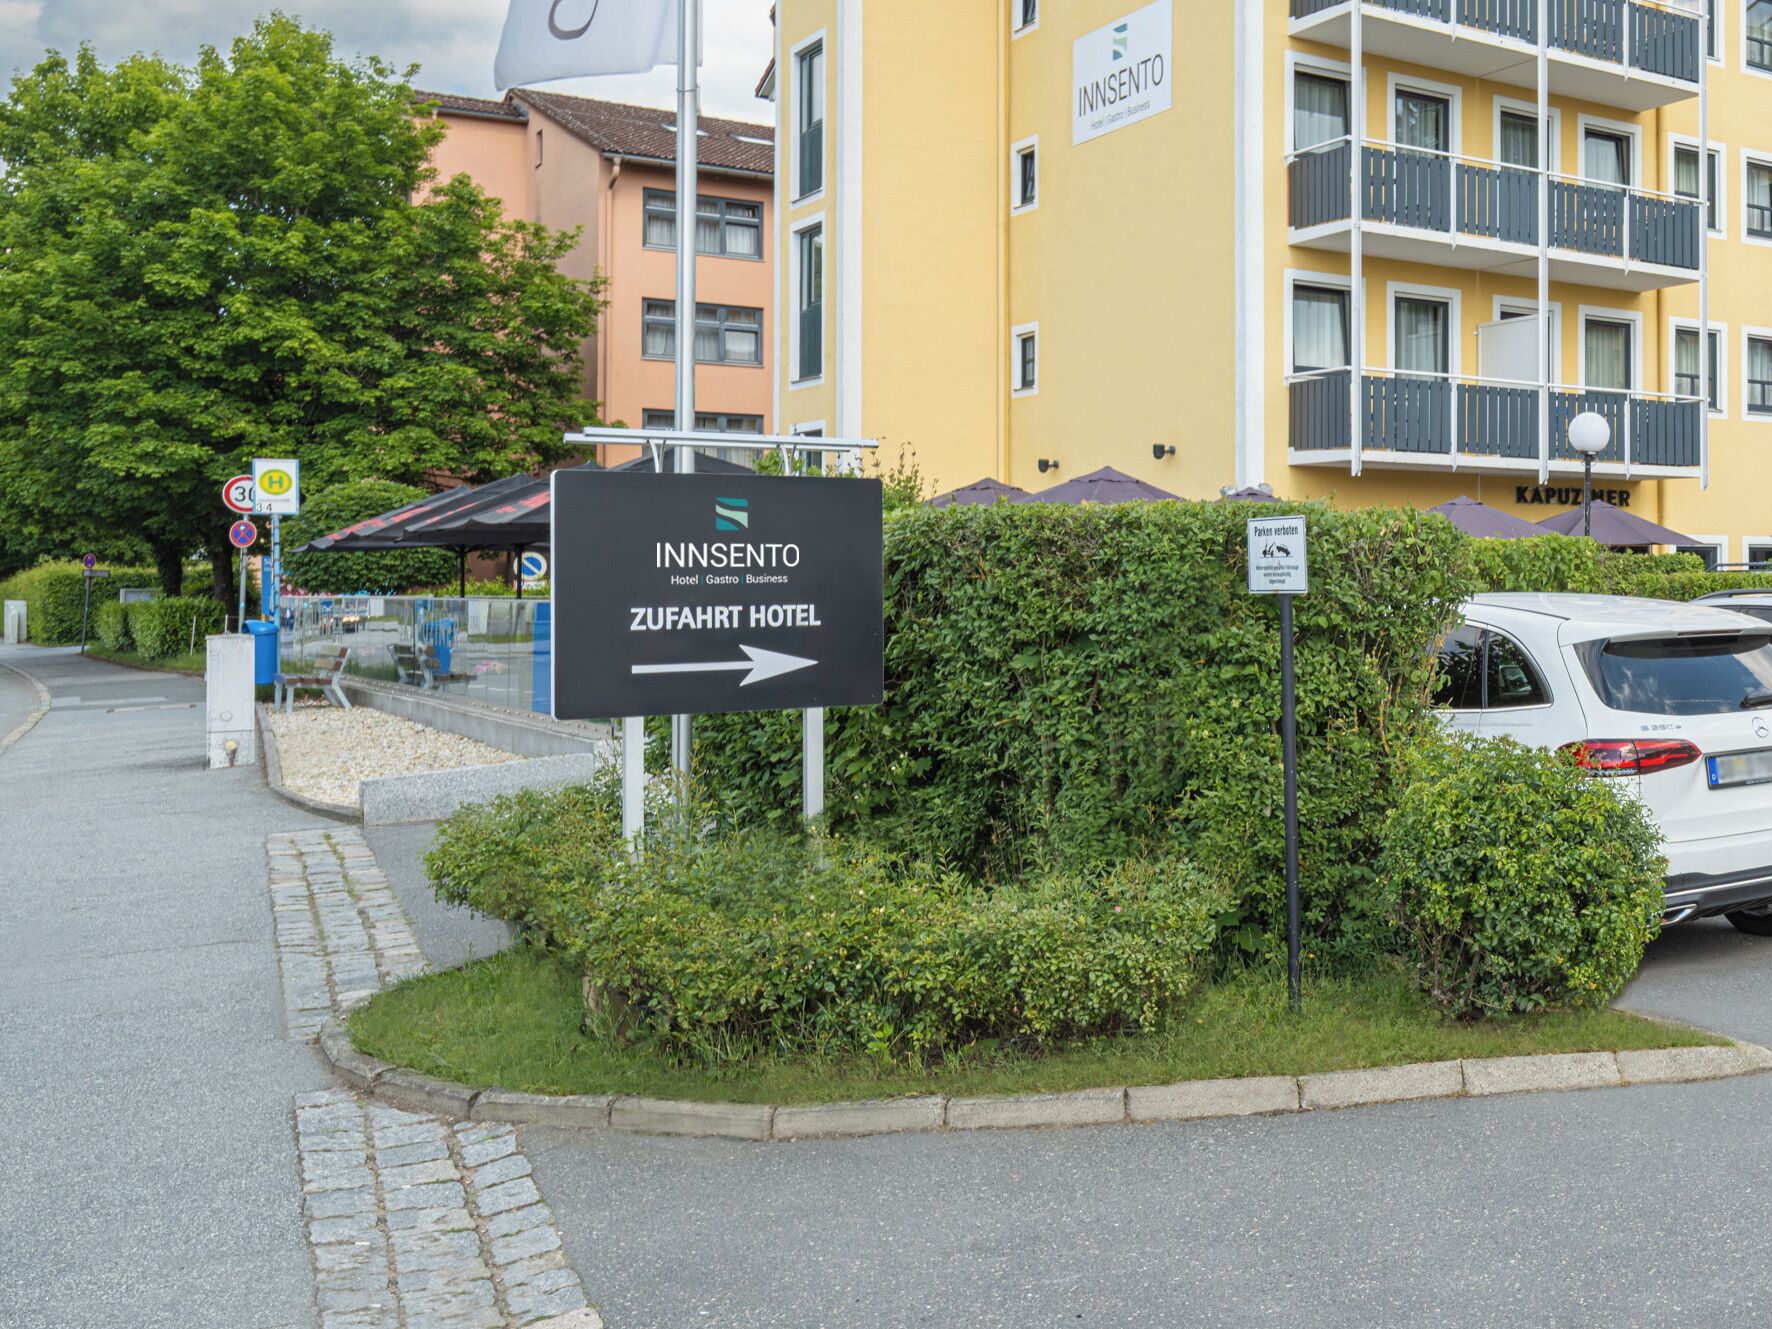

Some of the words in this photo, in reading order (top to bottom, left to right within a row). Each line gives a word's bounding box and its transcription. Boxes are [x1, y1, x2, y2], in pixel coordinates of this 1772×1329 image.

[1078, 53, 1164, 118] INNSENTO
[1516, 486, 1631, 507] KAPUZNER
[1254, 526, 1273, 537] Parken
[1274, 525, 1299, 536] verboten
[656, 542, 800, 568] INNSENTO
[671, 574, 699, 585] Hotel
[706, 574, 739, 585] Gastro
[746, 573, 788, 584] Business
[630, 606, 743, 631] ZUFAHRT
[750, 603, 821, 629] HOTEL
